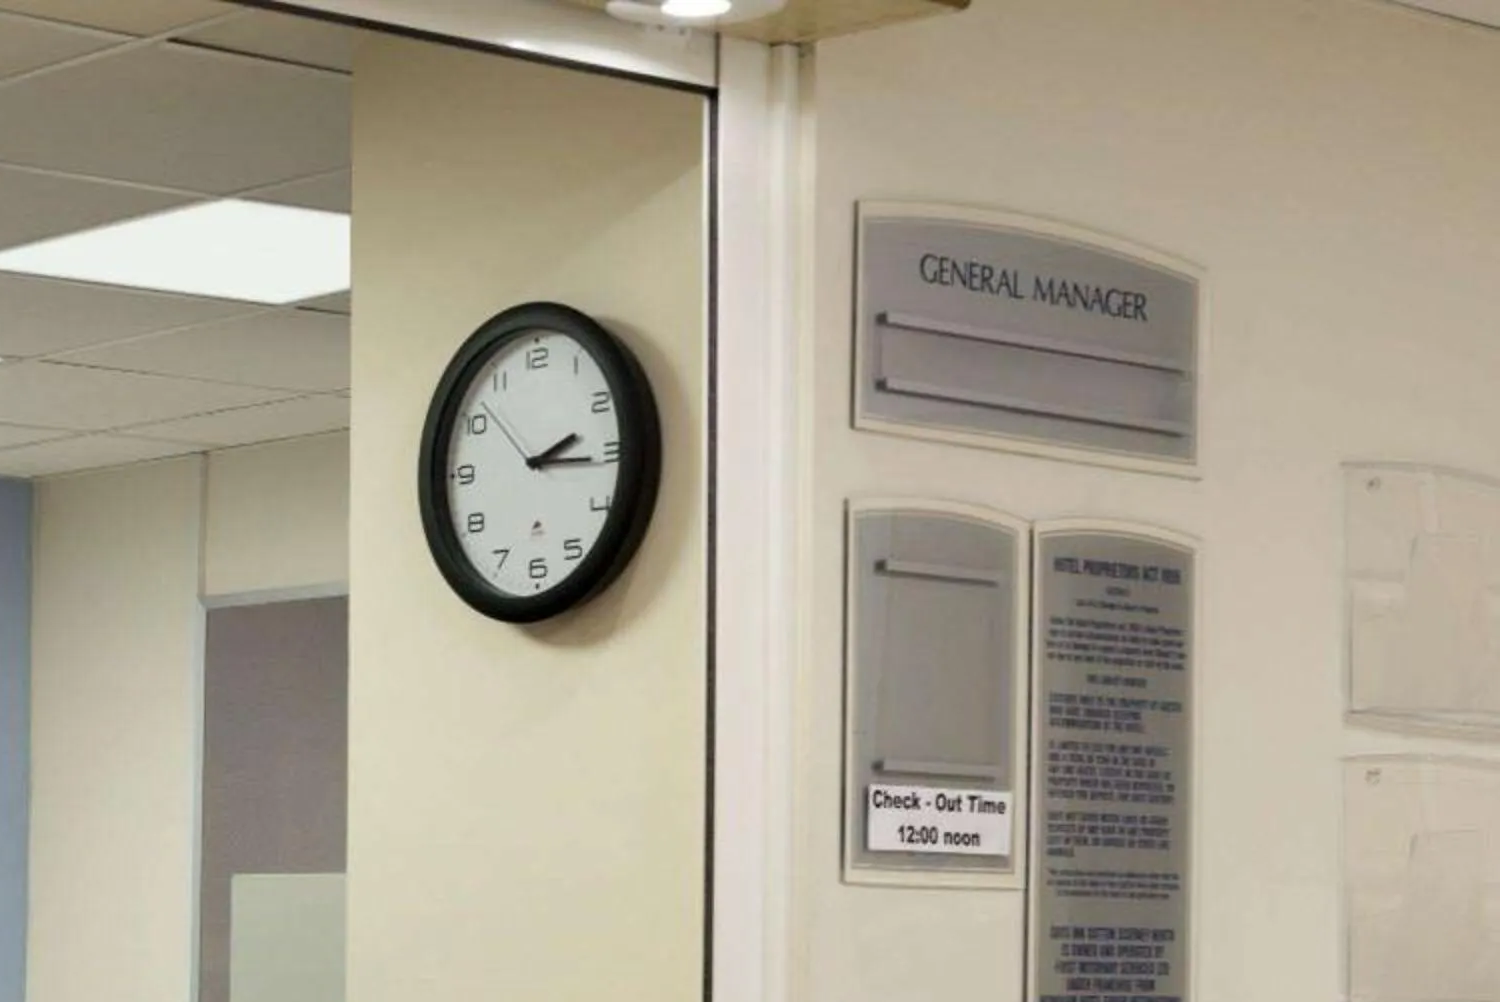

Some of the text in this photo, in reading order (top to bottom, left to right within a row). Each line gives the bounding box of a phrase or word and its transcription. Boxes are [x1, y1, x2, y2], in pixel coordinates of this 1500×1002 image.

[919, 253, 1149, 322] GENERAL MANAGER
[525, 347, 549, 371] 12
[493, 371, 508, 392] 11
[591, 391, 610, 414] 2
[466, 414, 488, 436] 10
[457, 464, 476, 485] 9
[467, 512, 485, 534] 8
[492, 549, 511, 570] 7
[563, 538, 584, 561] 5
[528, 558, 549, 580] 6
[872, 789, 921, 810] Check
[935, 793, 963, 812] Out
[967, 795, 1006, 815] Time
[897, 825, 981, 847] 12:00 noon
